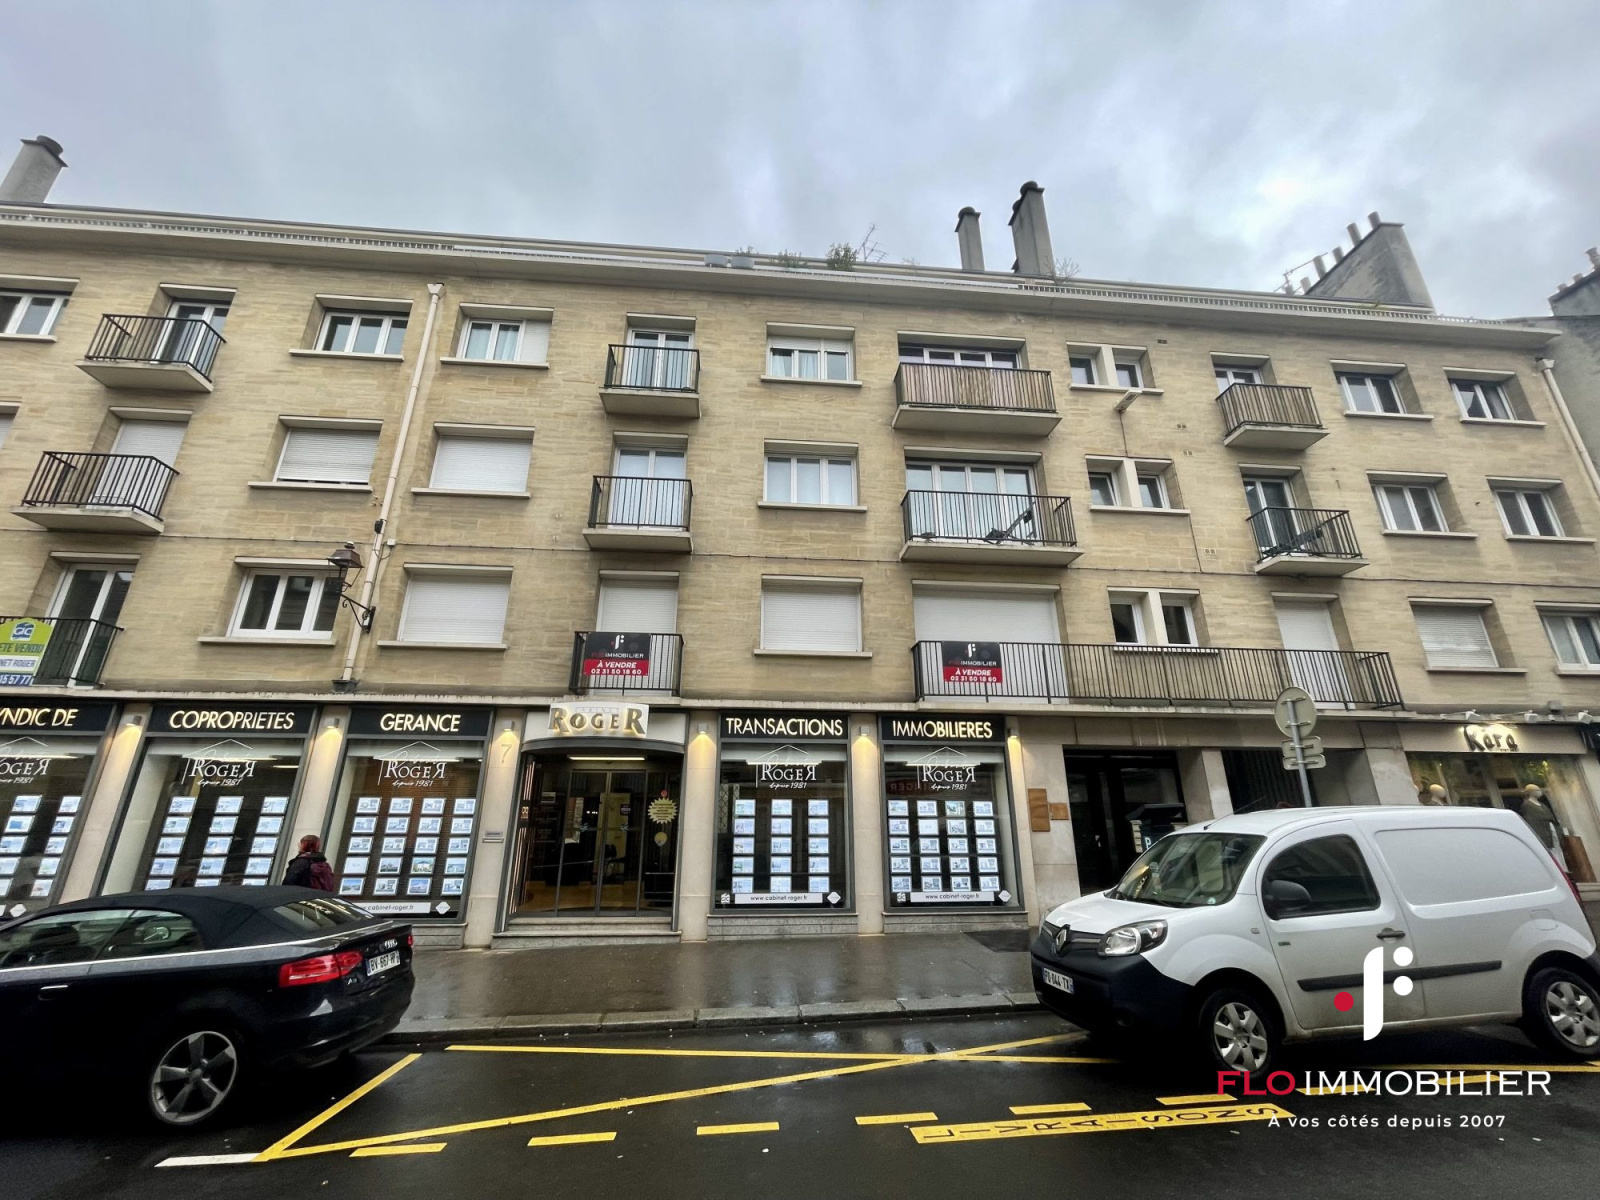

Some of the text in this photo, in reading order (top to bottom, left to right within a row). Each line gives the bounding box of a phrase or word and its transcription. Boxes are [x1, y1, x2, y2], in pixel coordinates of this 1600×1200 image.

[52, 709, 79, 727] DE
[169, 710, 295, 730] COPROPRIETES
[380, 713, 461, 732] GERANCE
[548, 708, 646, 735] ROGER
[726, 717, 843, 737] TRANSACTIONS
[892, 720, 993, 739] IMMOBILIERES
[501, 744, 512, 763] 7
[1144, 837, 1152, 849] P
[750, 894, 808, 902] www.cabinet-roger.fr
